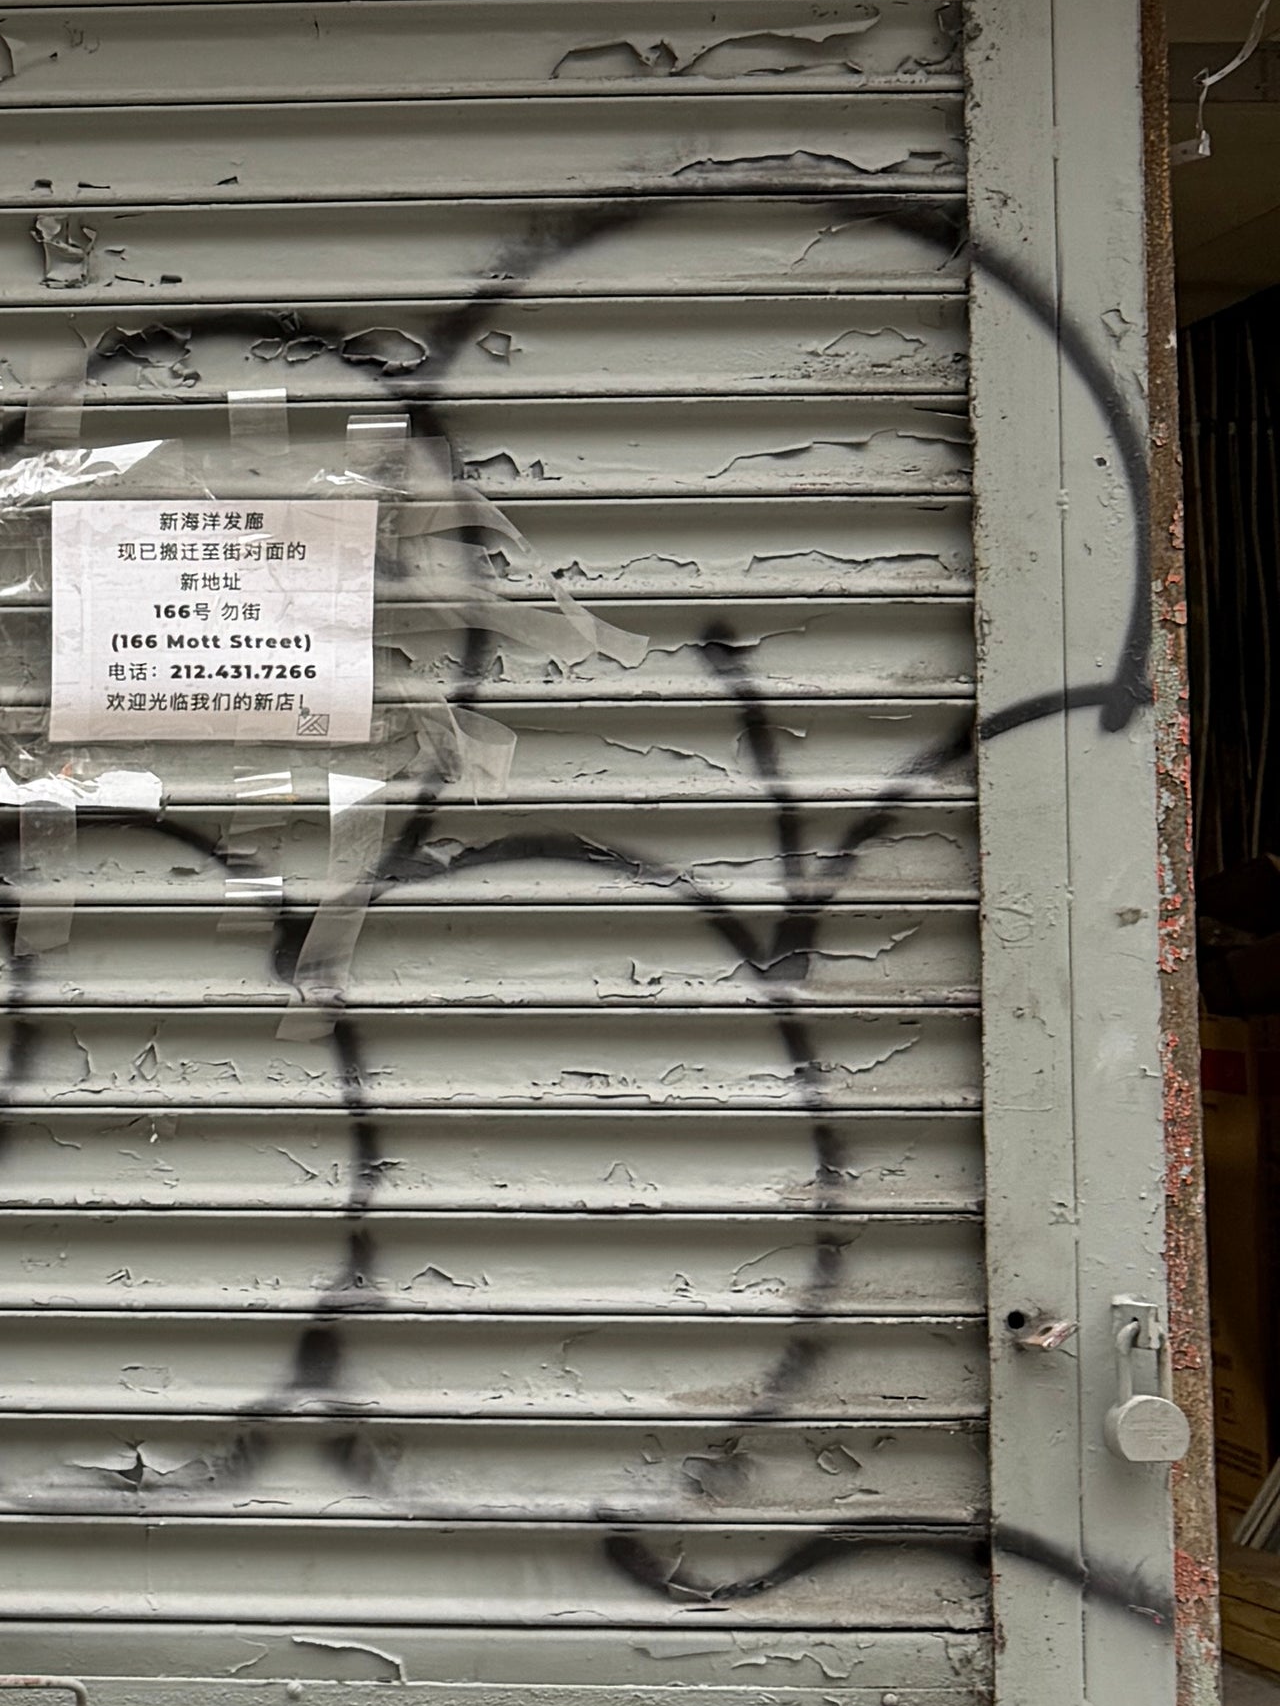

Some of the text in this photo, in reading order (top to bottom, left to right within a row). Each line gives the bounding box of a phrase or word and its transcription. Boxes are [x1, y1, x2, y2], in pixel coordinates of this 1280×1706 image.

[158, 511, 265, 532] 新海洋发廊
[116, 542, 307, 562] 现已搬迁至街对面的
[179, 572, 242, 592] 新地址
[153, 602, 262, 622] 166号 勿街
[111, 633, 312, 652] (166 Mott Street)
[169, 664, 317, 680] 212.431.7266
